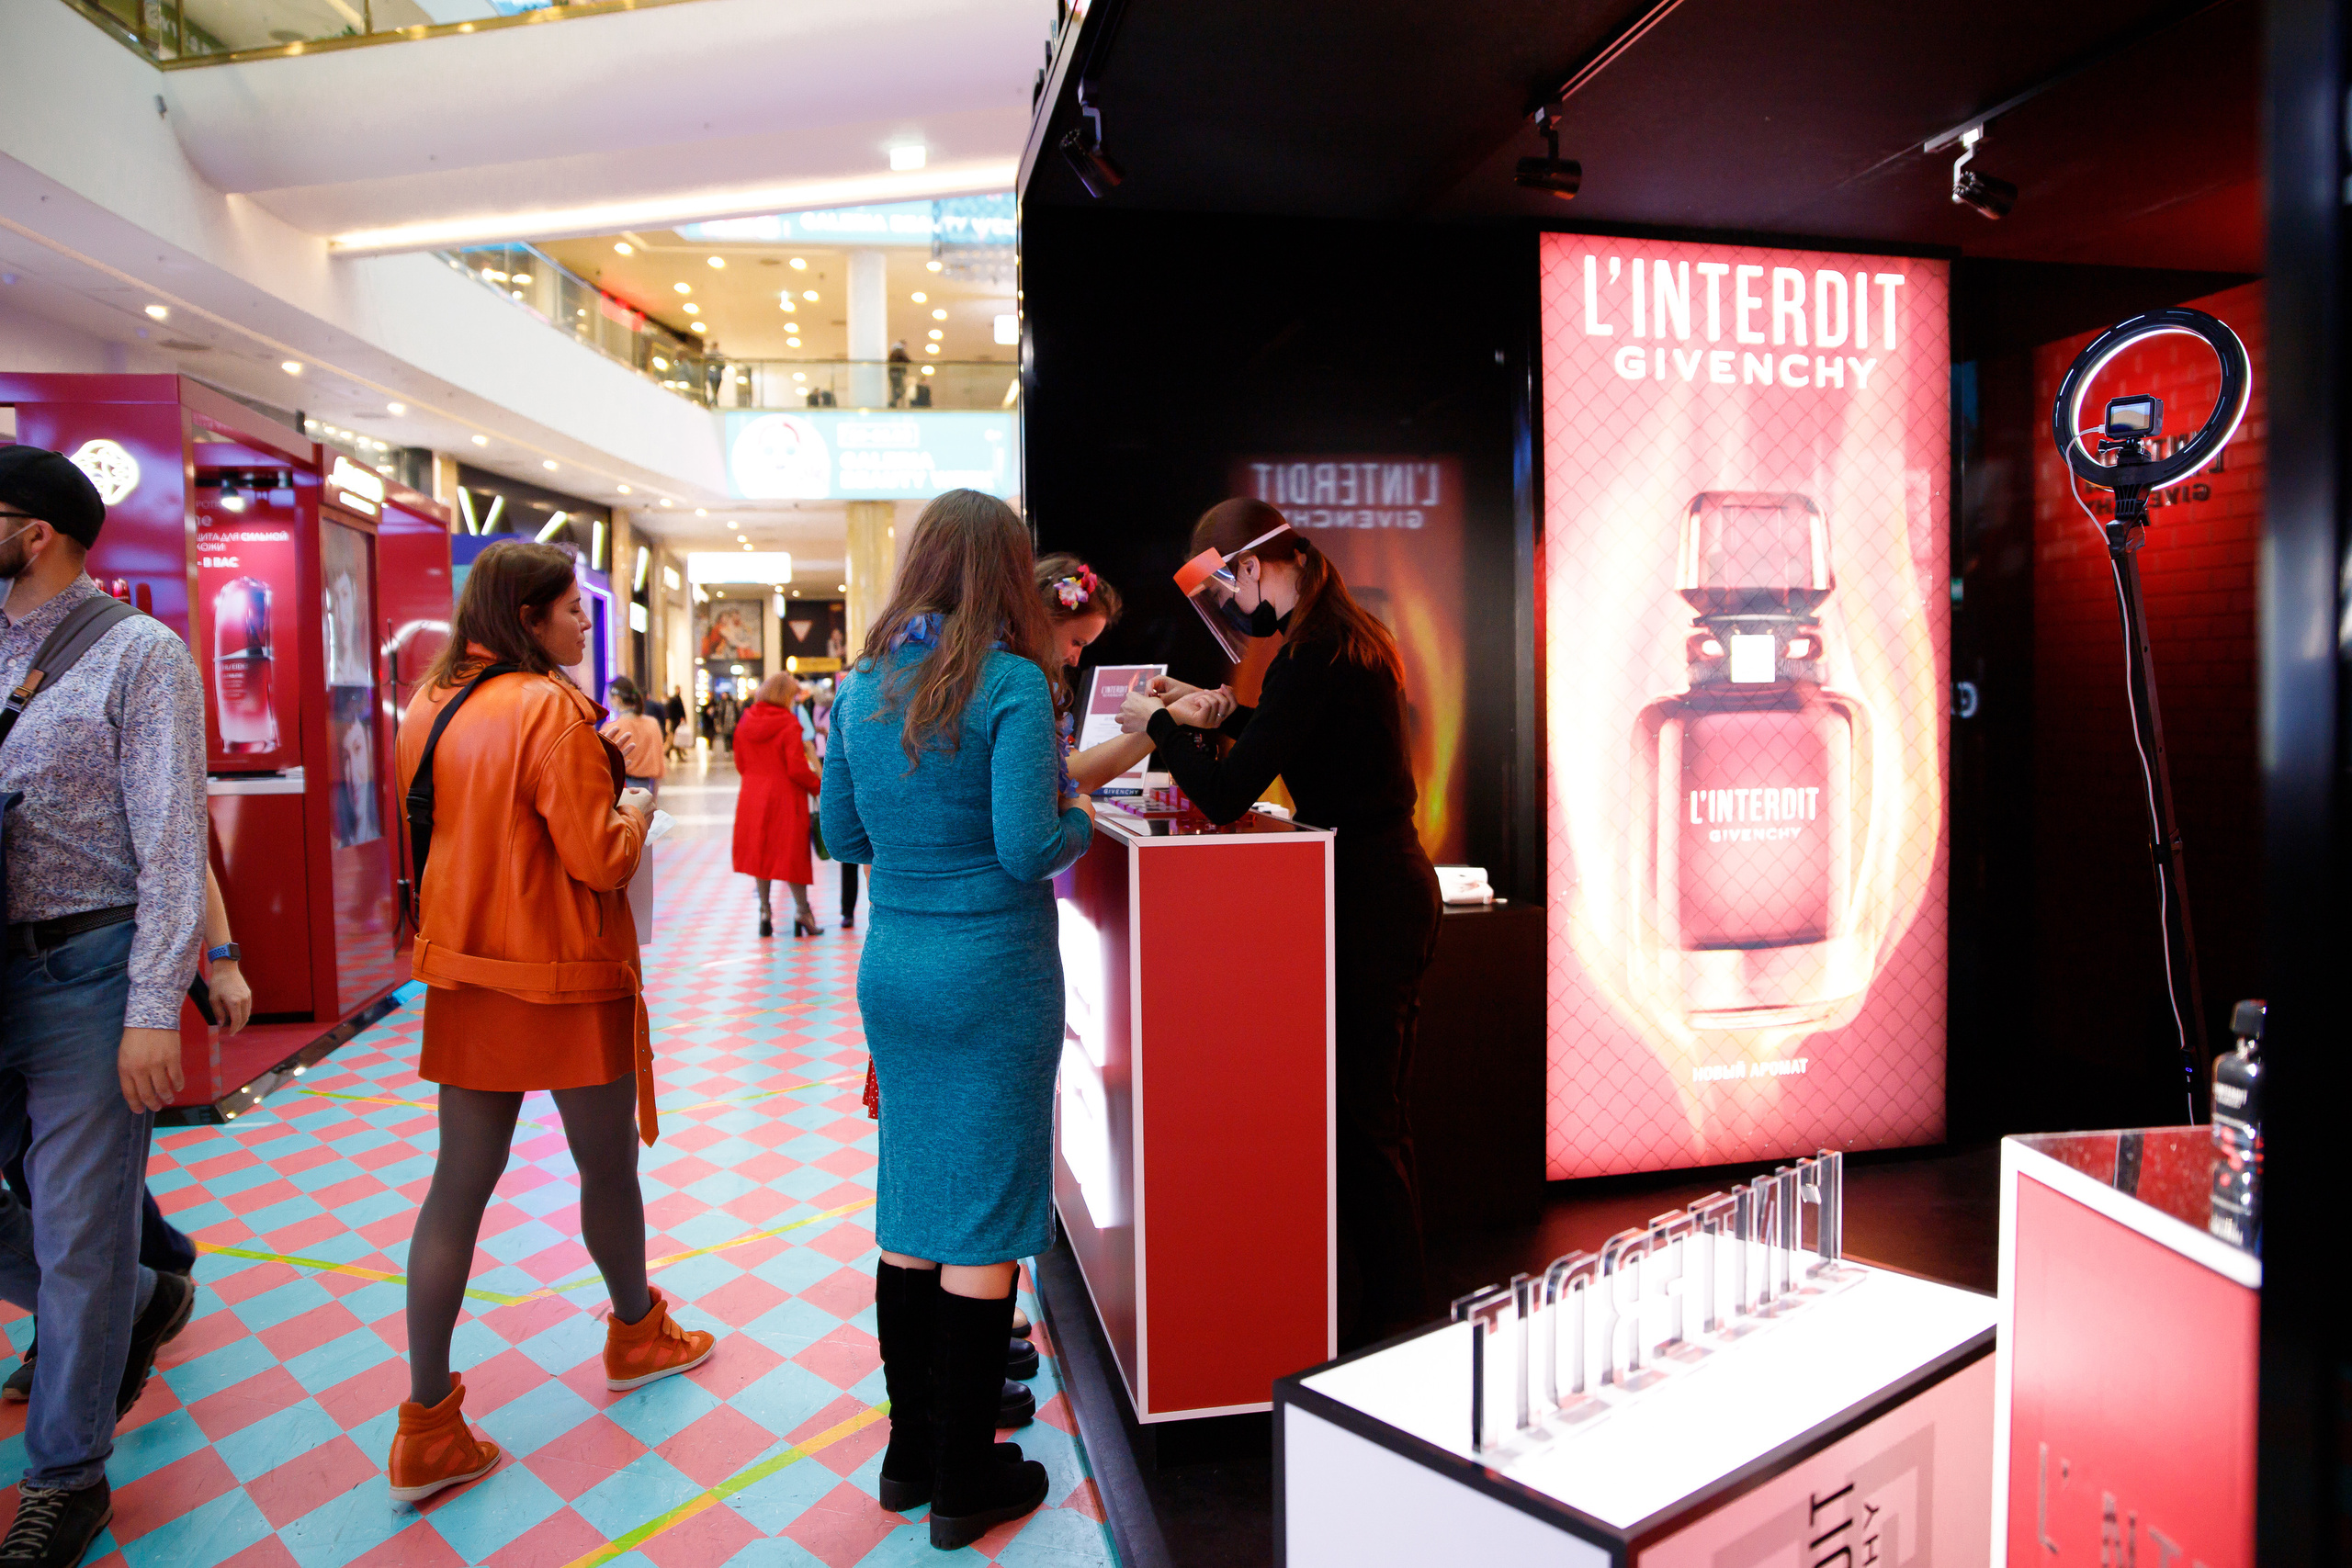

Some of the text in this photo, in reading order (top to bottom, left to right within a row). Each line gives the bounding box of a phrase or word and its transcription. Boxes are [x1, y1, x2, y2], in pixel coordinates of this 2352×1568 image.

[1583, 254, 1905, 351] L'INTERDIT
[1614, 344, 1878, 390] GIVENCHY
[240, 530, 289, 542] СИЛЬНОЙ
[213, 556, 240, 568] ВАС
[1690, 787, 1820, 824] L'INTERDIT
[1709, 827, 1802, 843] GIVENCHY
[1692, 1057, 1809, 1082] НОВЫЙ АРОМАТ
